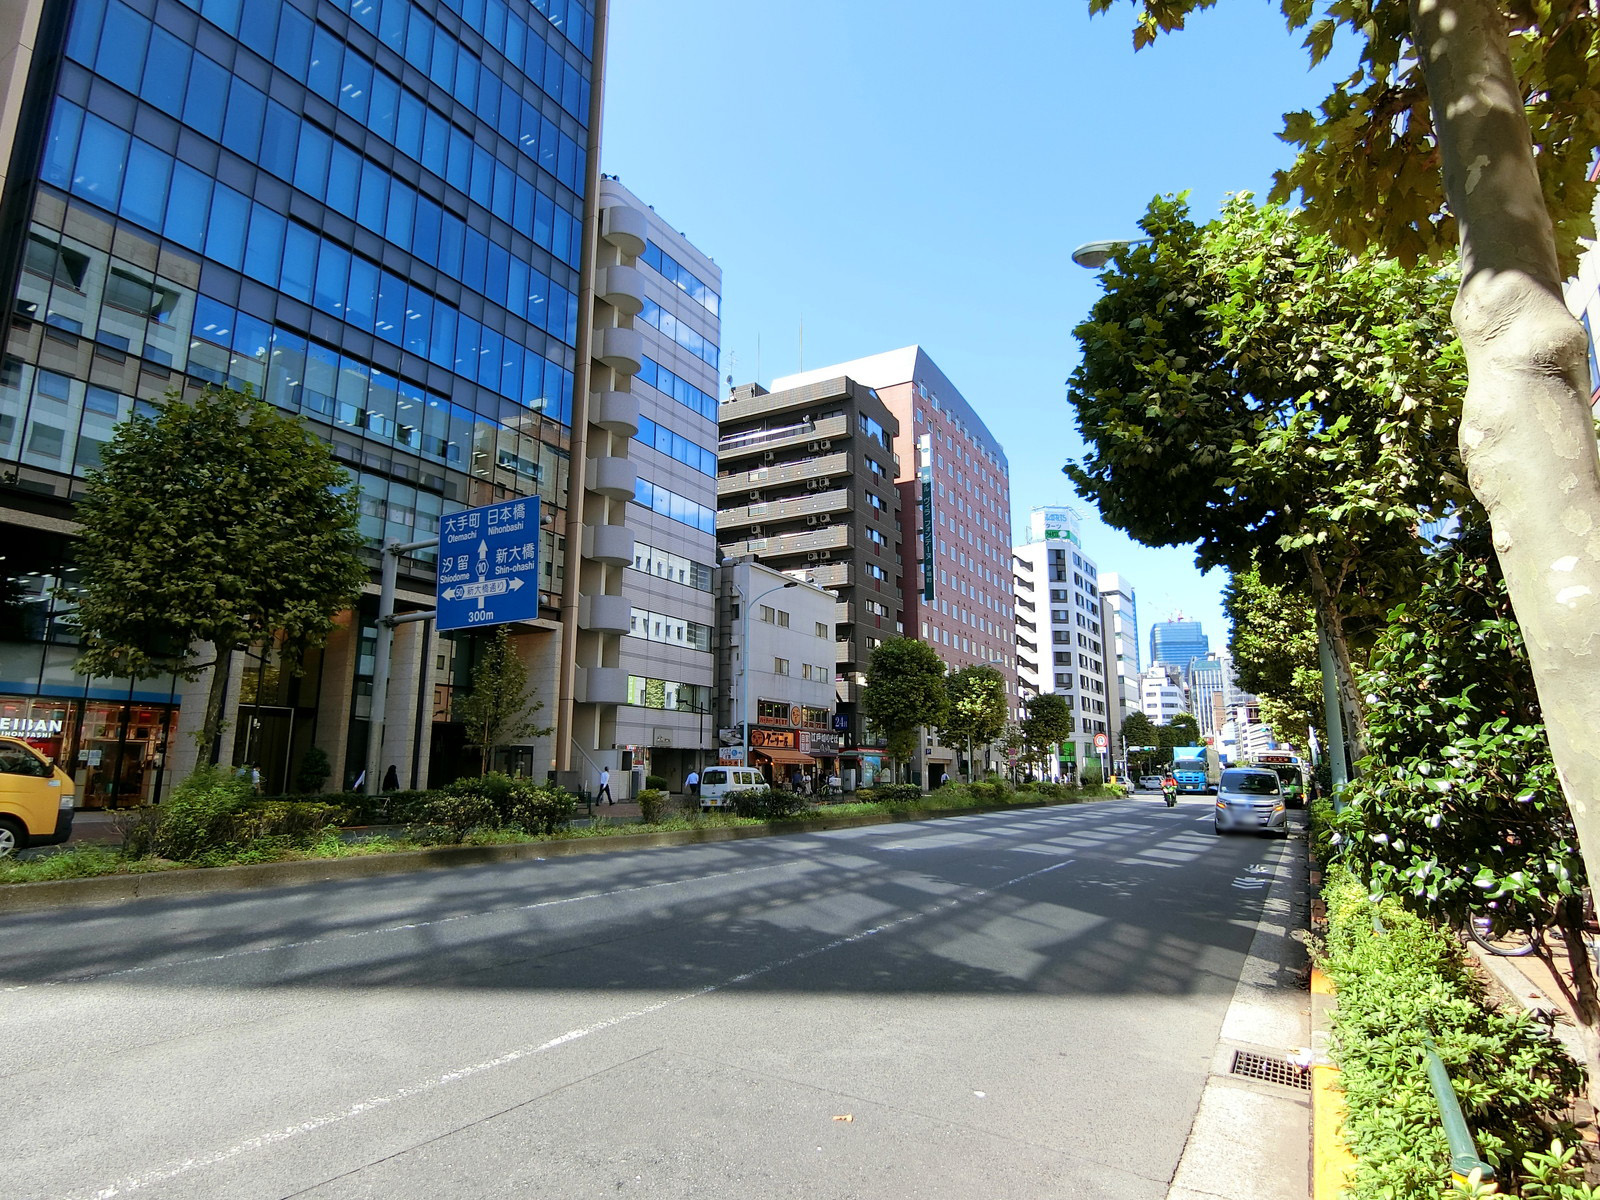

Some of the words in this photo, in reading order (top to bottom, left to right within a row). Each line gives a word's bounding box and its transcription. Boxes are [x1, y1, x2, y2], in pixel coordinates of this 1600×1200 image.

[488, 503, 525, 525] 日本橋
[445, 513, 480, 534] 大手町
[488, 521, 524, 535] Nihonbashi
[448, 530, 477, 543] Otemachi
[496, 543, 535, 564] 新大橋
[478, 562, 486, 573] 10
[495, 560, 535, 575] Shin-ohashi
[440, 572, 470, 584] Shiodome
[467, 583, 504, 596] 新大橋通り
[468, 610, 494, 623] 300m
